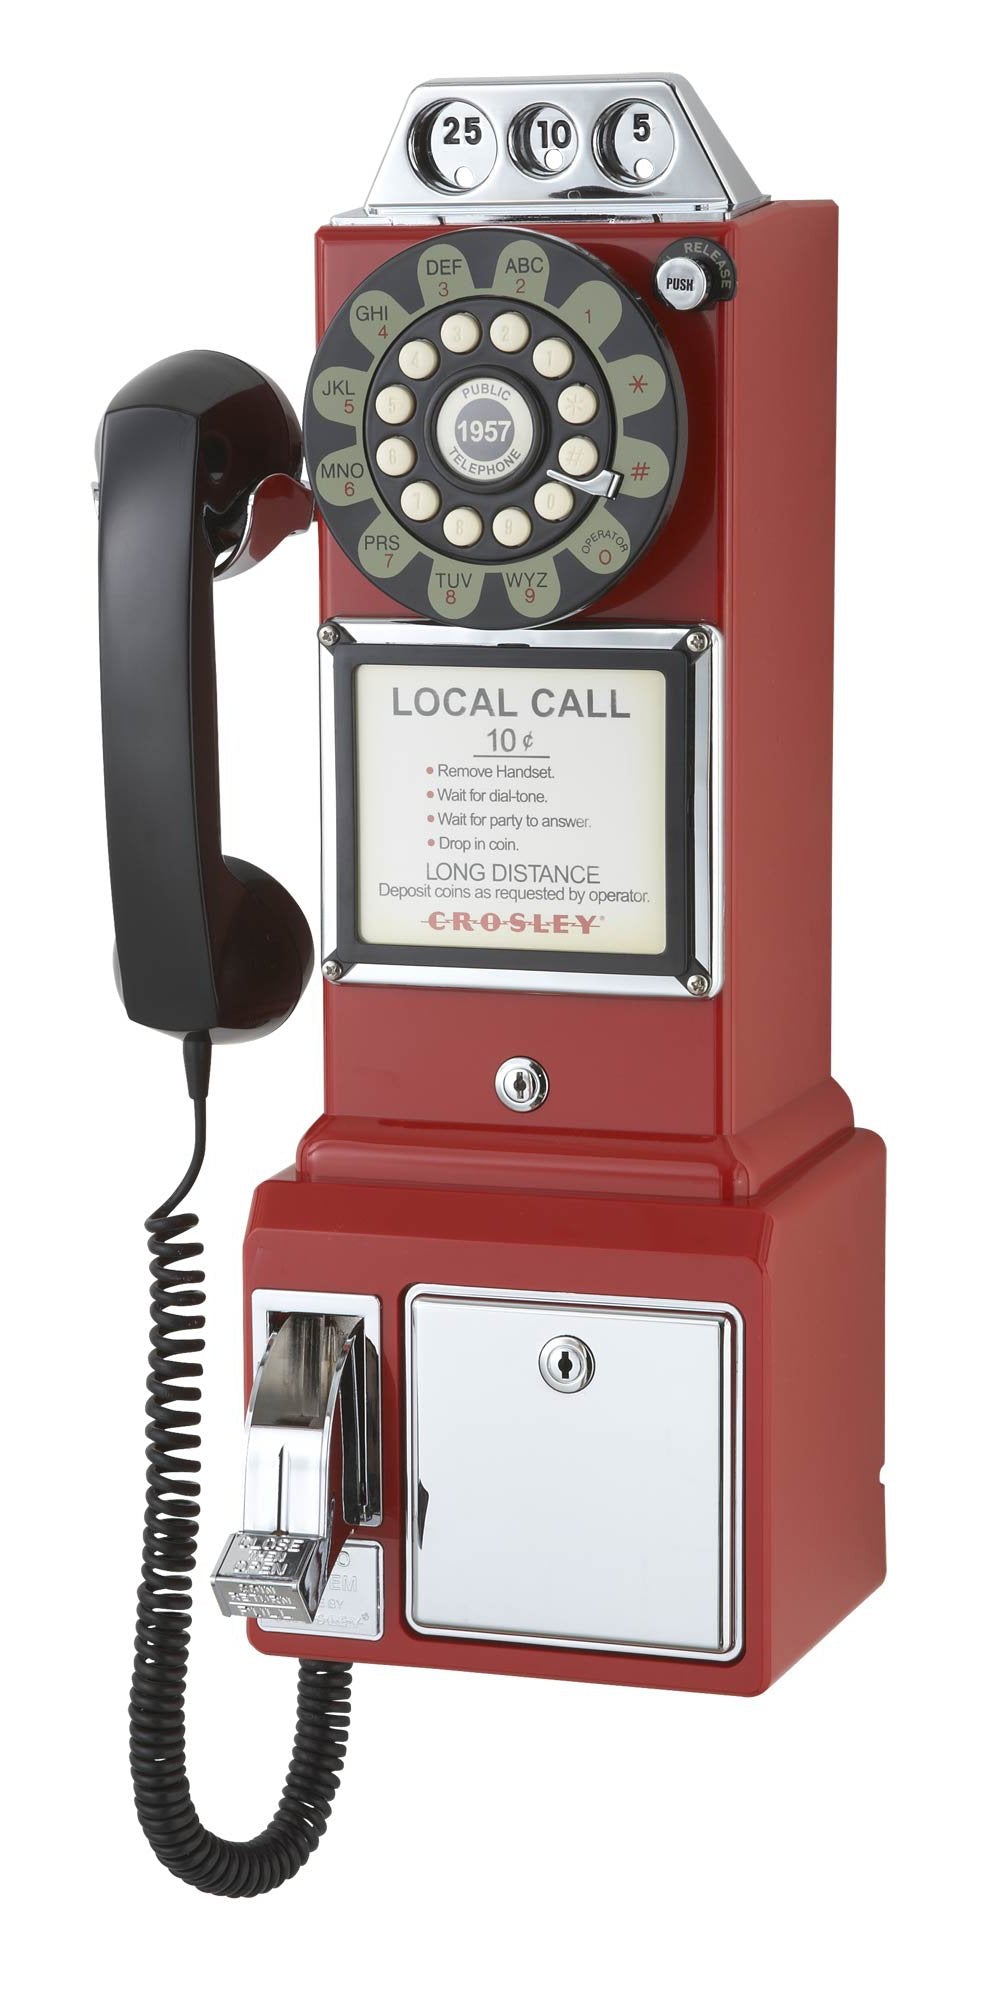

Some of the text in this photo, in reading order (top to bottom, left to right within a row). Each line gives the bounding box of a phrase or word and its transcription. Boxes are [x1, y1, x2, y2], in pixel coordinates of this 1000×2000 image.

[442, 116, 483, 146] 25
[537, 119, 571, 149] 10
[633, 113, 652, 142] 5
[426, 258, 463, 276] DEF
[504, 256, 544, 274] ABC
[684, 242, 731, 288] RELEASE
[438, 282, 449, 297] 3
[515, 279, 525, 294] 2
[666, 277, 693, 291] PUSH
[355, 305, 388, 322] GHI
[584, 310, 592, 323] 1
[378, 325, 389, 339] 4
[322, 380, 355, 396] JKL
[462, 383, 512, 401] PUBLIC
[344, 399, 354, 414] 5
[457, 420, 512, 443] 1957
[449, 447, 522, 475] TELEPHONE
[320, 462, 364, 478] MNO
[344, 482, 355, 497] 6
[364, 535, 400, 551] PRS
[581, 529, 629, 555] OPERATOR
[384, 553, 394, 568] 7
[435, 573, 472, 588] TUV
[504, 573, 548, 588] WYZ
[445, 589, 456, 605] 8
[524, 587, 536, 604] 9
[392, 686, 631, 718] LOCAL CALL
[487, 728, 516, 752] 10
[438, 764, 555, 779] Remove Handset.
[437, 788, 548, 803] Wait for dial-tone.
[438, 812, 592, 830] Wait for party to answer.
[439, 836, 519, 853] Drop in coin.
[426, 862, 601, 884] LONG DISTANCE
[379, 883, 650, 905] Deposit coins as requested by operator.
[239, 1536, 304, 1552] CLOSE
[234, 1560, 287, 1575] OPEN
